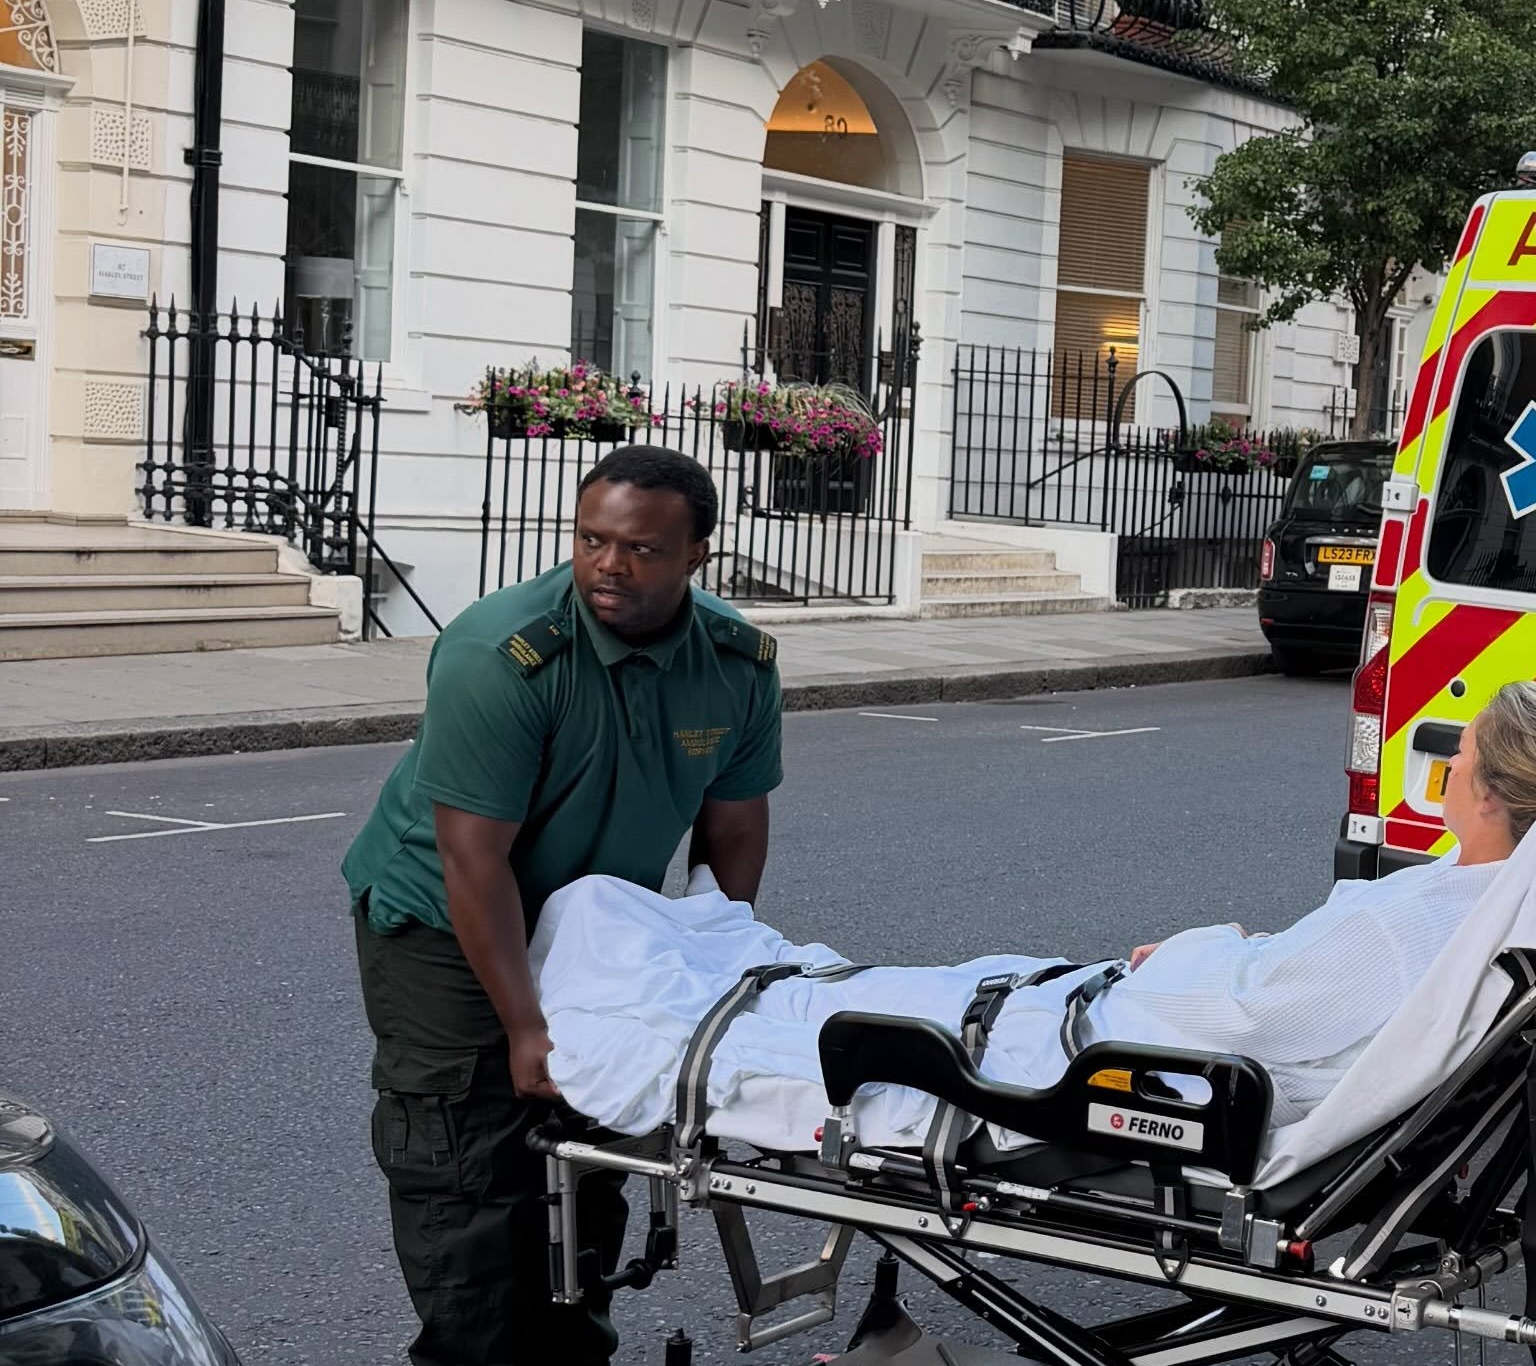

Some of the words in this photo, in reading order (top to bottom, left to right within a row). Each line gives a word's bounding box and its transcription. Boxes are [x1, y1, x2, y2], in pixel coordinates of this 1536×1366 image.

[824, 114, 848, 138] 80
[1323, 547, 1353, 560] LS23
[1128, 1116, 1184, 1140] FERNO
